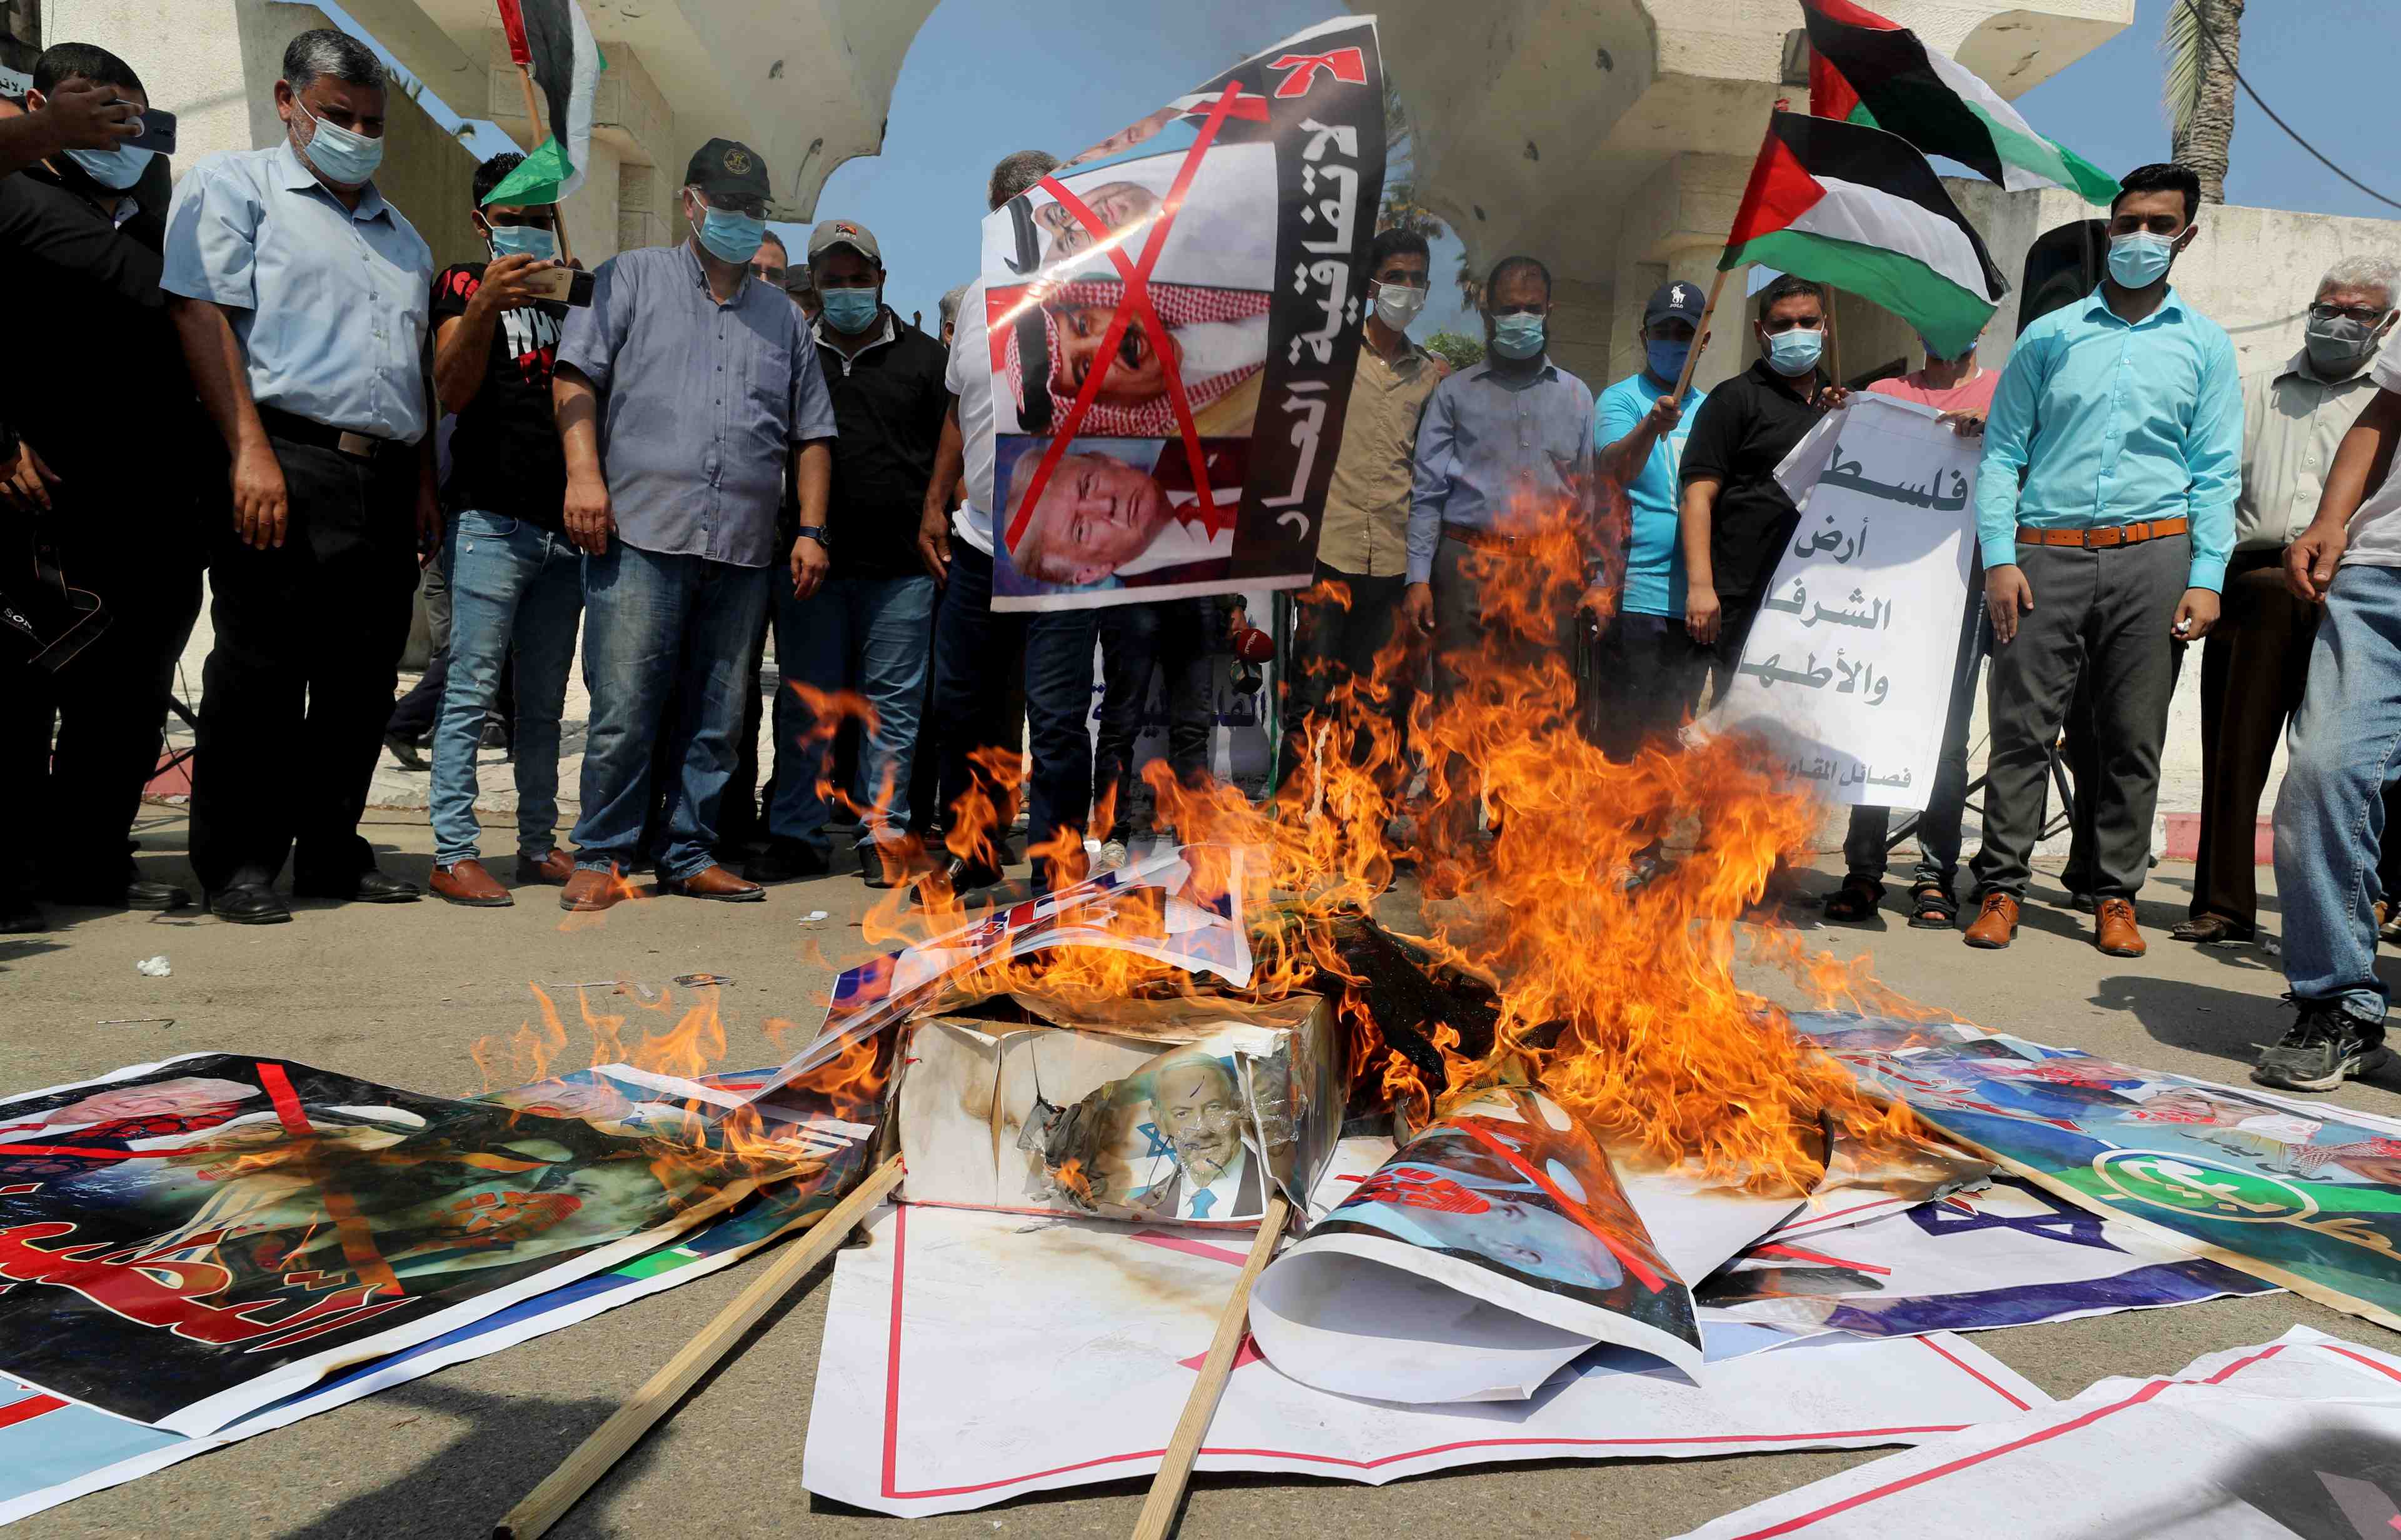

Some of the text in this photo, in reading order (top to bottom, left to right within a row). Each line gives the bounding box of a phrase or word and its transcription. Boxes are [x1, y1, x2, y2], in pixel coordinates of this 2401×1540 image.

[1266, 46, 1368, 99] لا
[1260, 117, 1360, 543] لاتفاقية العار
[1817, 442, 1967, 511] فلسط
[1793, 515, 1870, 564] أرض
[4, 608, 32, 630] SON
[1764, 576, 1891, 631] الشرفا
[1738, 644, 1889, 706] والأطها
[1839, 760, 1912, 788] فصائل
